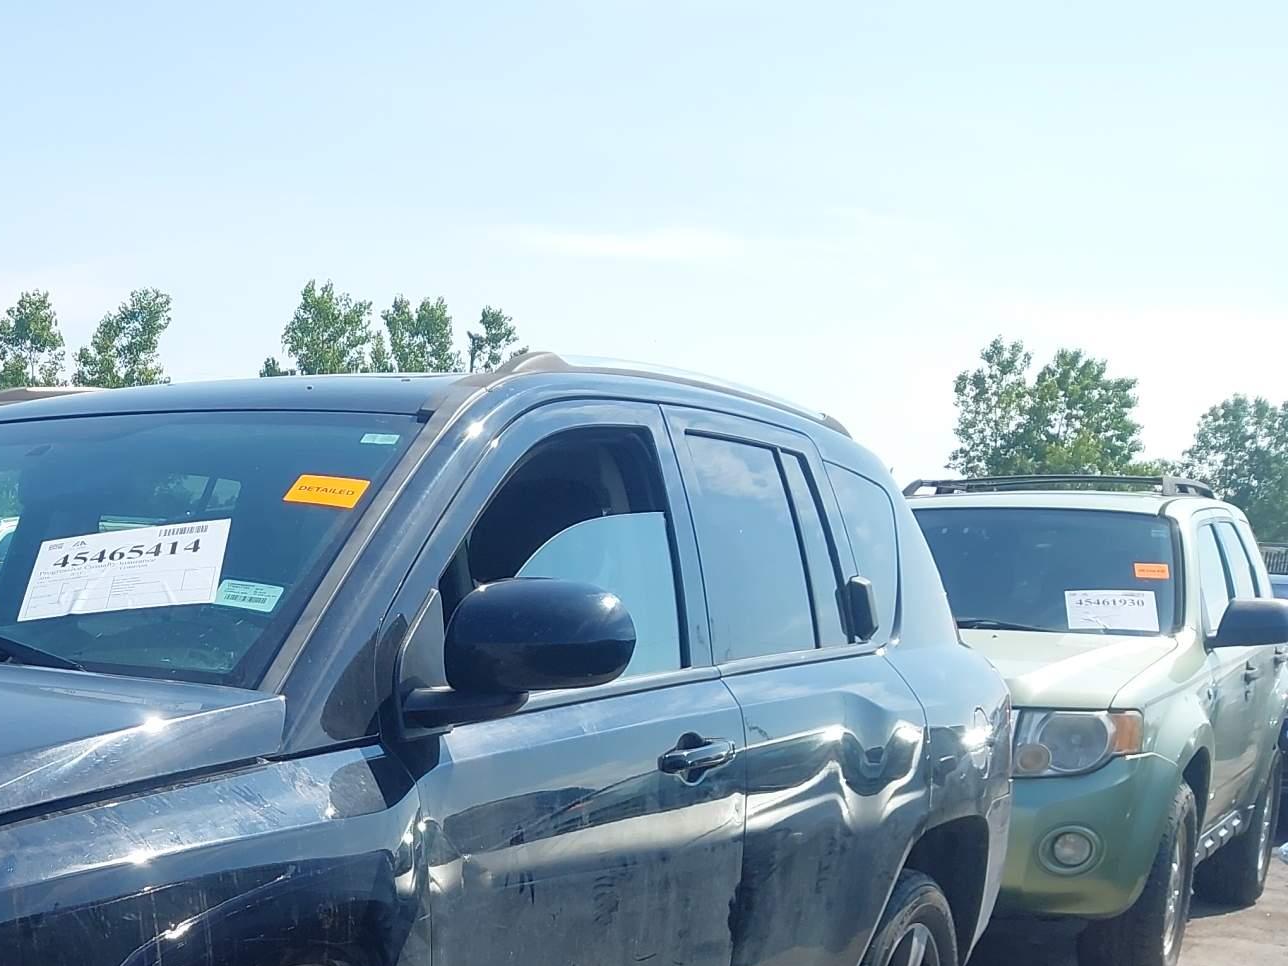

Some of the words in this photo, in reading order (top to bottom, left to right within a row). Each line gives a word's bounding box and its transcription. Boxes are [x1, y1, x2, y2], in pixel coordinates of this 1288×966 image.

[298, 485, 355, 496] DETAILED
[53, 538, 201, 567] 45465414
[1075, 598, 1145, 607] 45461930
